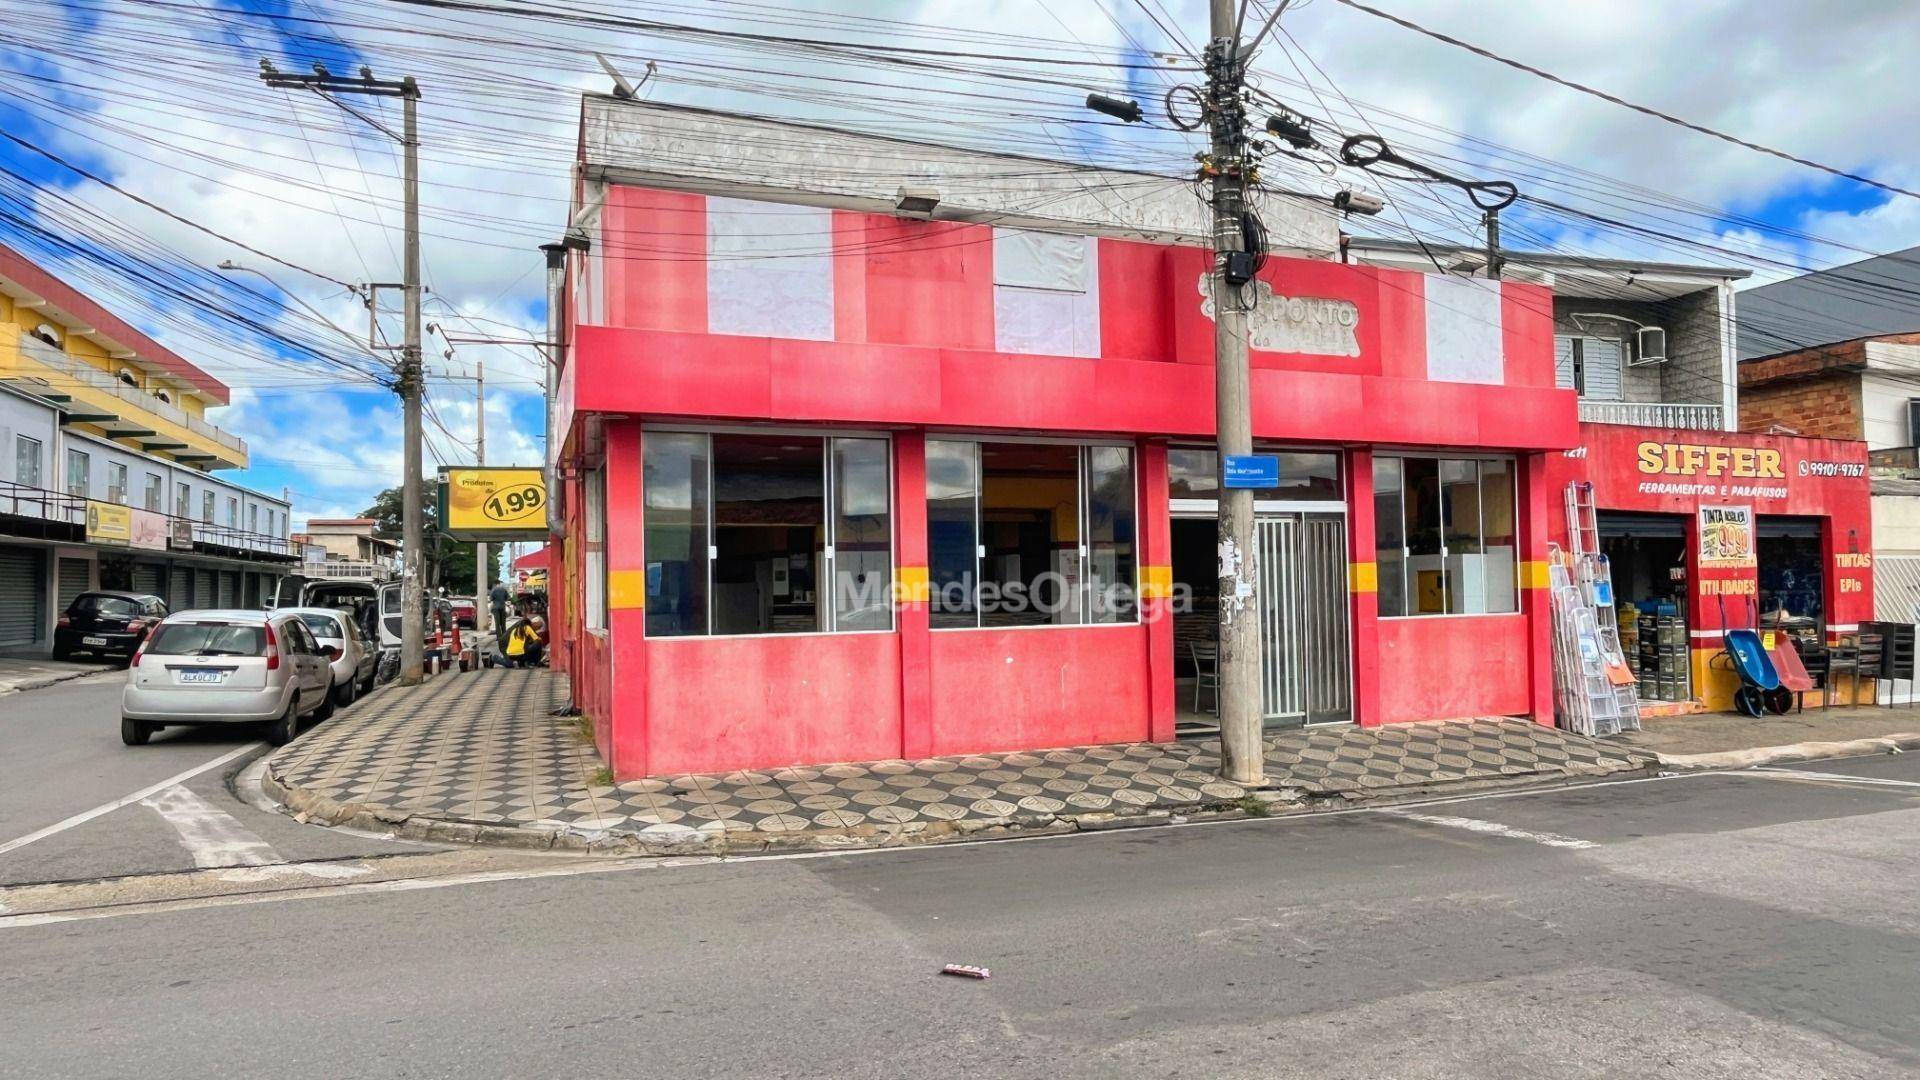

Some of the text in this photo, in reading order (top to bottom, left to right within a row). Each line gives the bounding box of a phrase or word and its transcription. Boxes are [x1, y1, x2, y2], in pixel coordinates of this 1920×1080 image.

[1637, 441, 1786, 479] SIFFER
[1809, 462, 1865, 477] 99101-9767
[1638, 482, 1788, 499] FERRAMENTAS E PARAFUSOS
[488, 487, 541, 518] 1,99
[1702, 508, 1723, 525] TINTA
[1835, 553, 1871, 568] TINTAS
[1699, 579, 1756, 595] UTILIDADES
